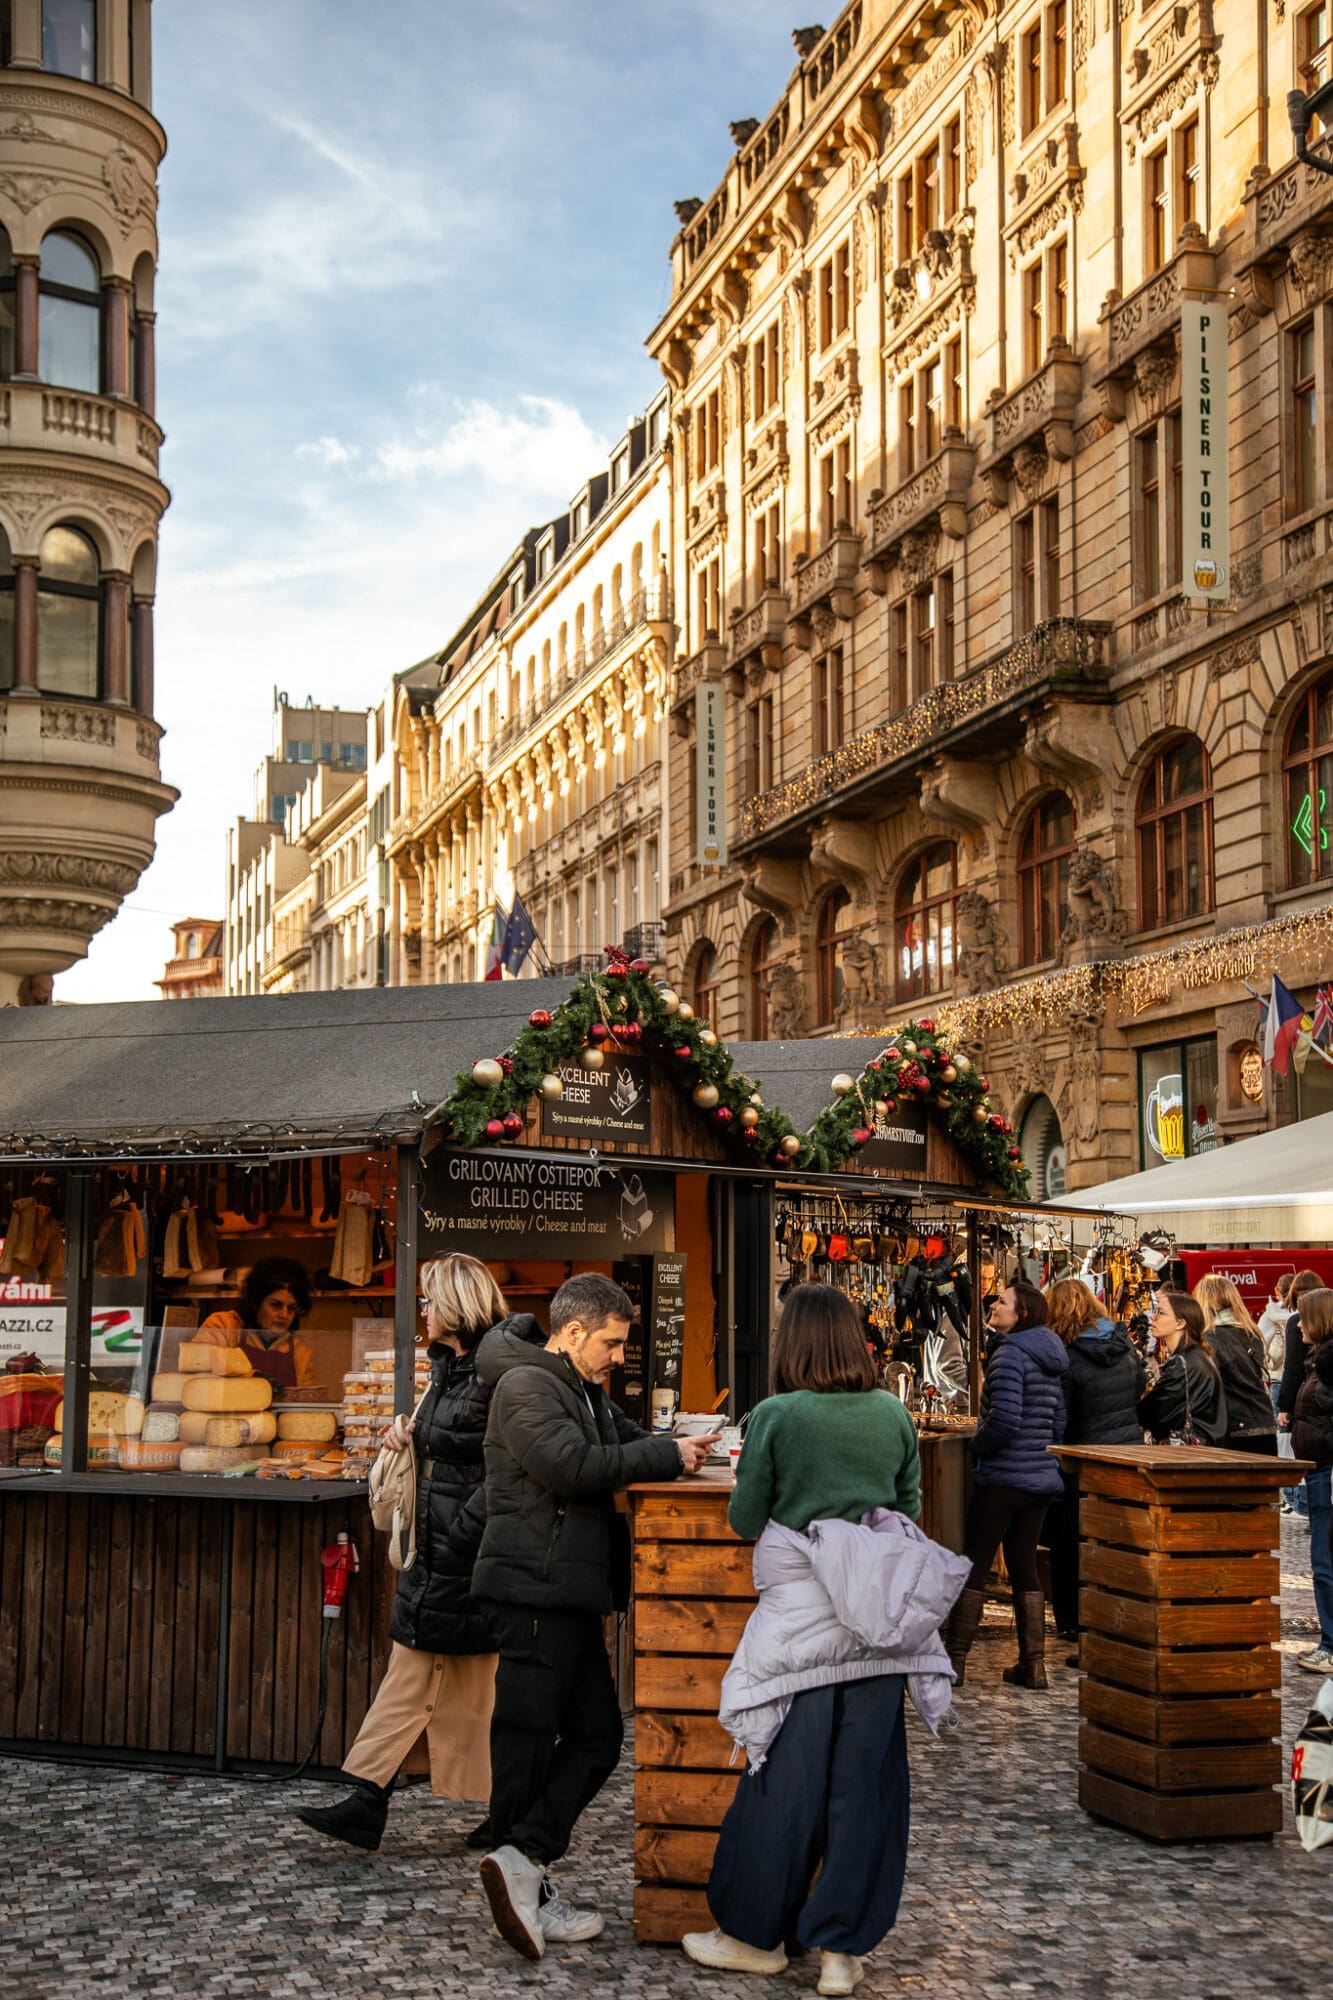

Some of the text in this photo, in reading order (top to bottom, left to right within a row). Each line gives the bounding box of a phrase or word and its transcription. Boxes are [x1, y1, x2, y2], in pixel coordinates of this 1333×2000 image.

[1200, 316, 1211, 549] PILSNER TOUR
[707, 691, 716, 778] PILSNER
[708, 786, 716, 835] TOUR
[553, 1066, 611, 1087] XCELLENT
[558, 1086, 591, 1104] HEESE
[449, 1158, 535, 1184] GRILOVANÝ
[470, 1186, 584, 1211] GRILLED CHEESE
[424, 1210, 608, 1234] Sýry a masné výrobky / Cheese and meat
[659, 1273, 680, 1284] CHEESE
